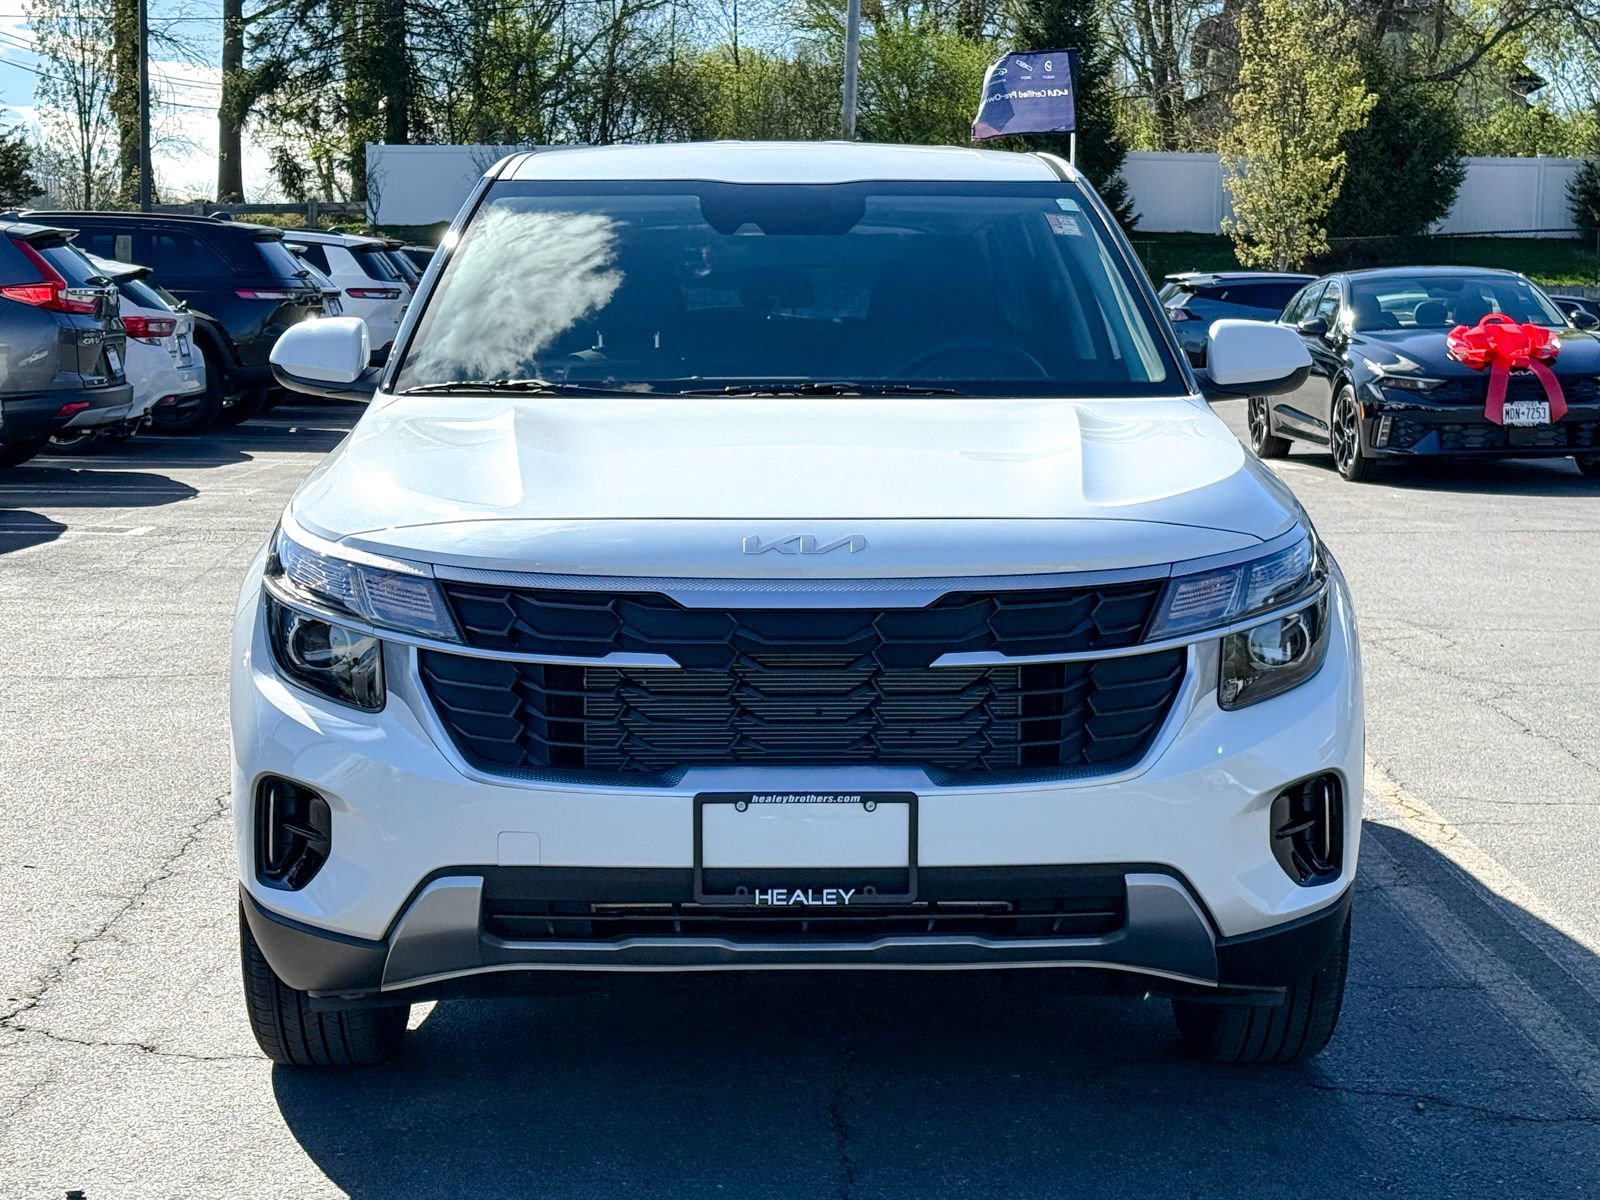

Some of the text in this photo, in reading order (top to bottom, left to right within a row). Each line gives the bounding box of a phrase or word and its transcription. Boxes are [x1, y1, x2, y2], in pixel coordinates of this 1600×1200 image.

[742, 534, 867, 555] KIA
[751, 794, 861, 804] healeybrothers.com
[755, 889, 856, 905] HEALEY
